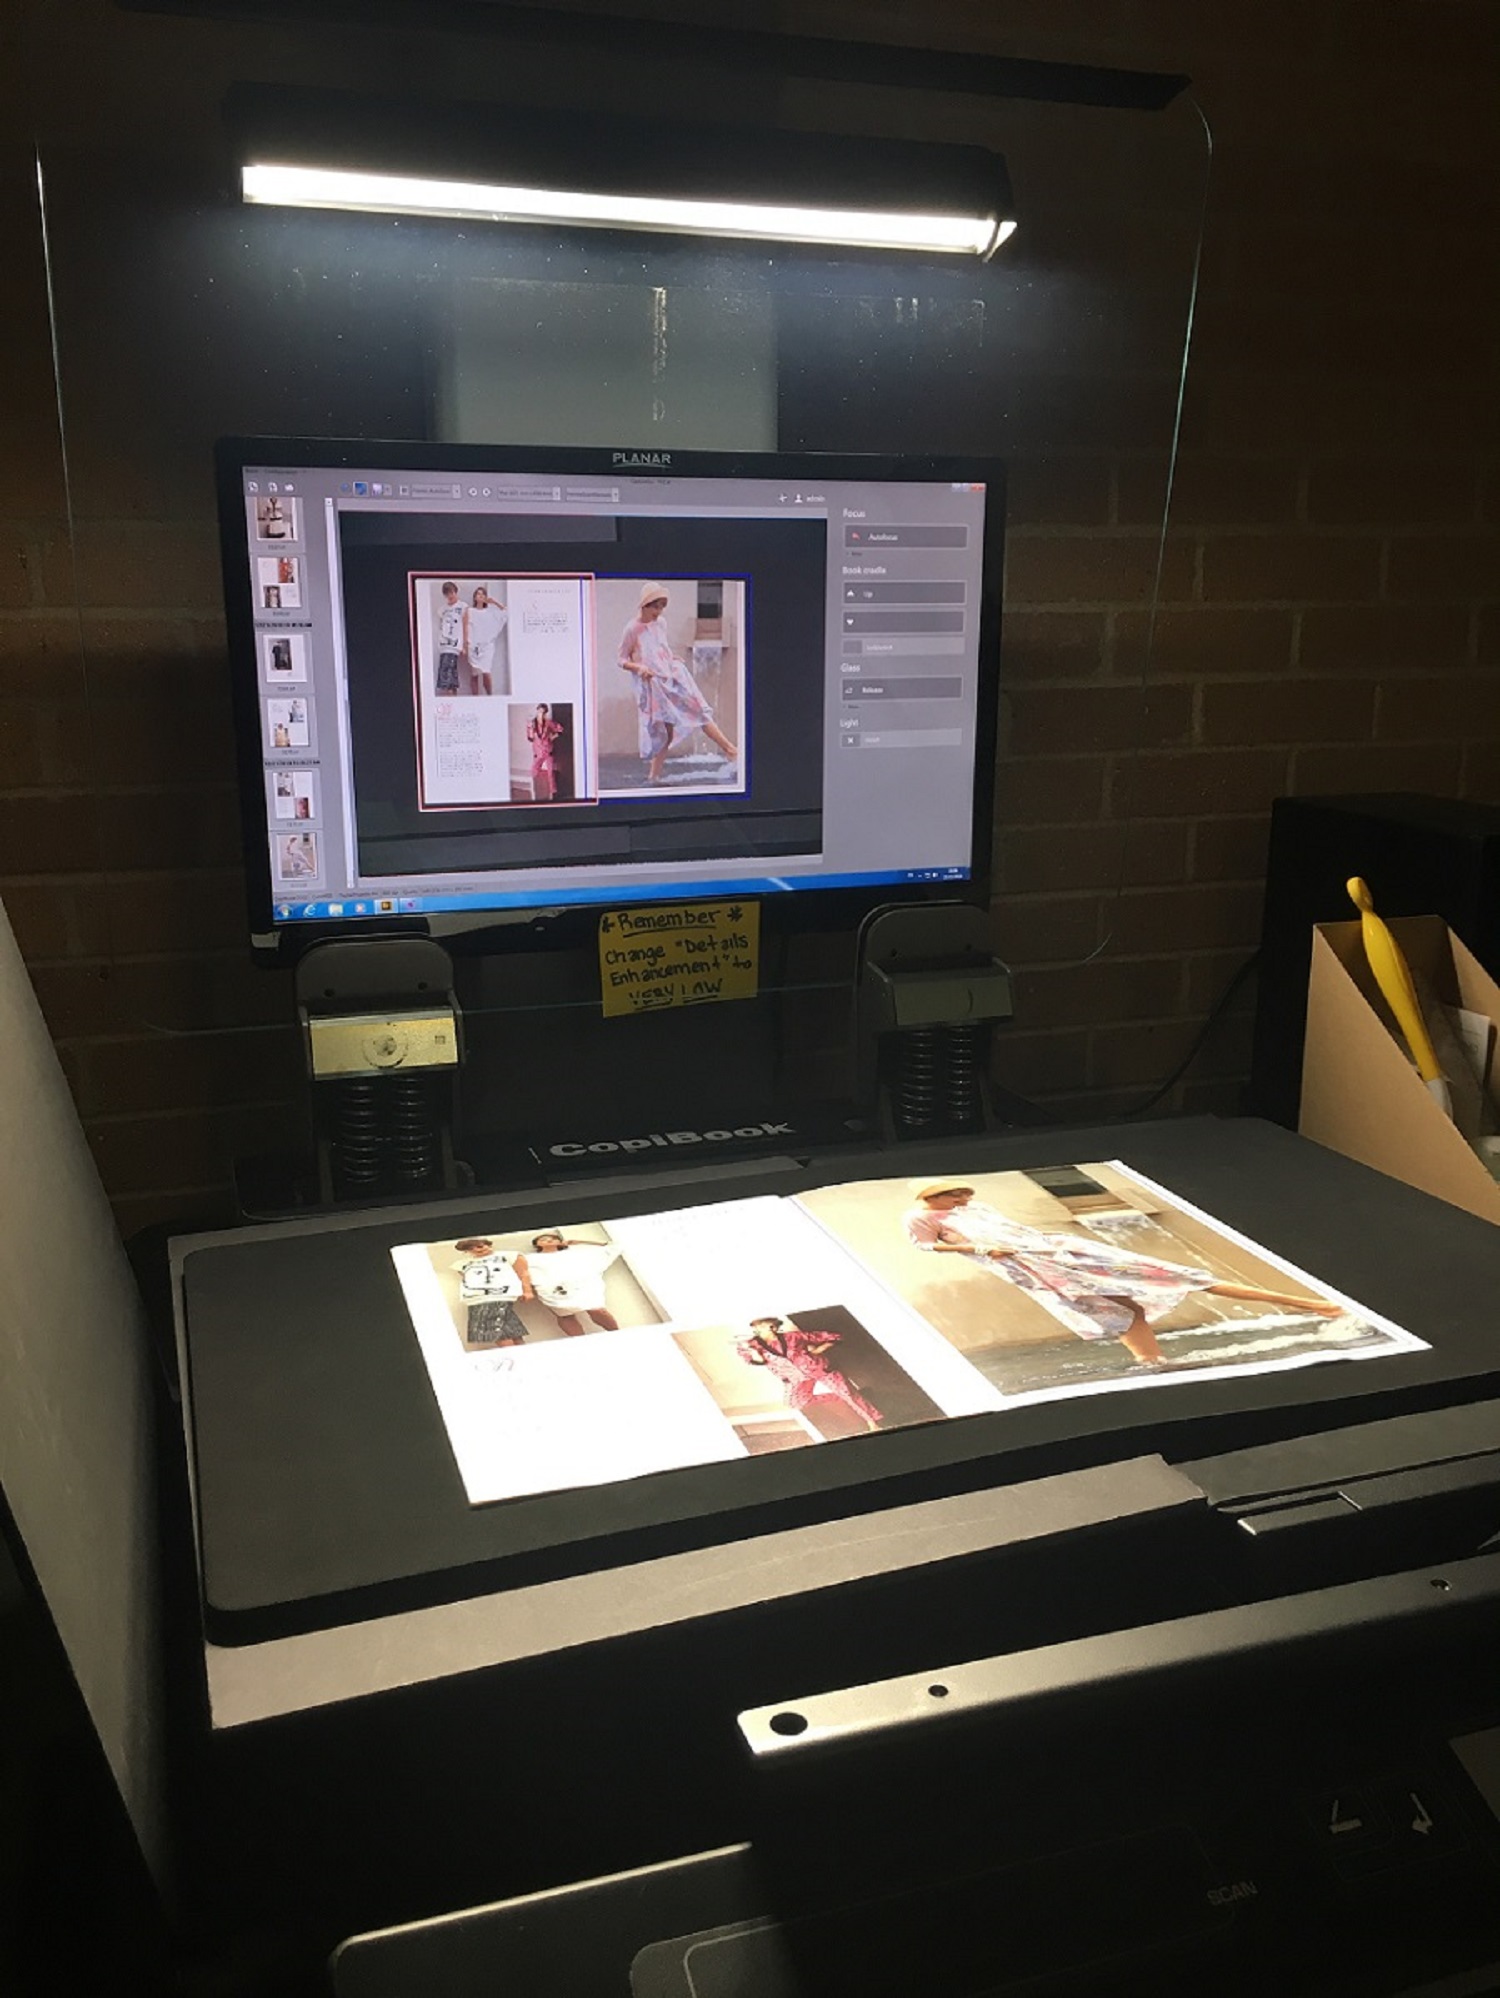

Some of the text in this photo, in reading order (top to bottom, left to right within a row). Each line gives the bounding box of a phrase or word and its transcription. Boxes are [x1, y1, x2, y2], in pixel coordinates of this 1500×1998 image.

[612, 452, 671, 464] PLANAR
[842, 508, 866, 518] Focus
[867, 532, 899, 542] Autofocus
[842, 566, 886, 575] Book cradle
[840, 662, 861, 673] Glass
[839, 718, 859, 728] Light
[617, 909, 721, 931] Remember
[605, 945, 666, 967] Change
[732, 956, 753, 970] to
[629, 982, 674, 1006] VERY
[550, 1122, 797, 1156] CopiBook
[1206, 1881, 1259, 1906] SCAN
